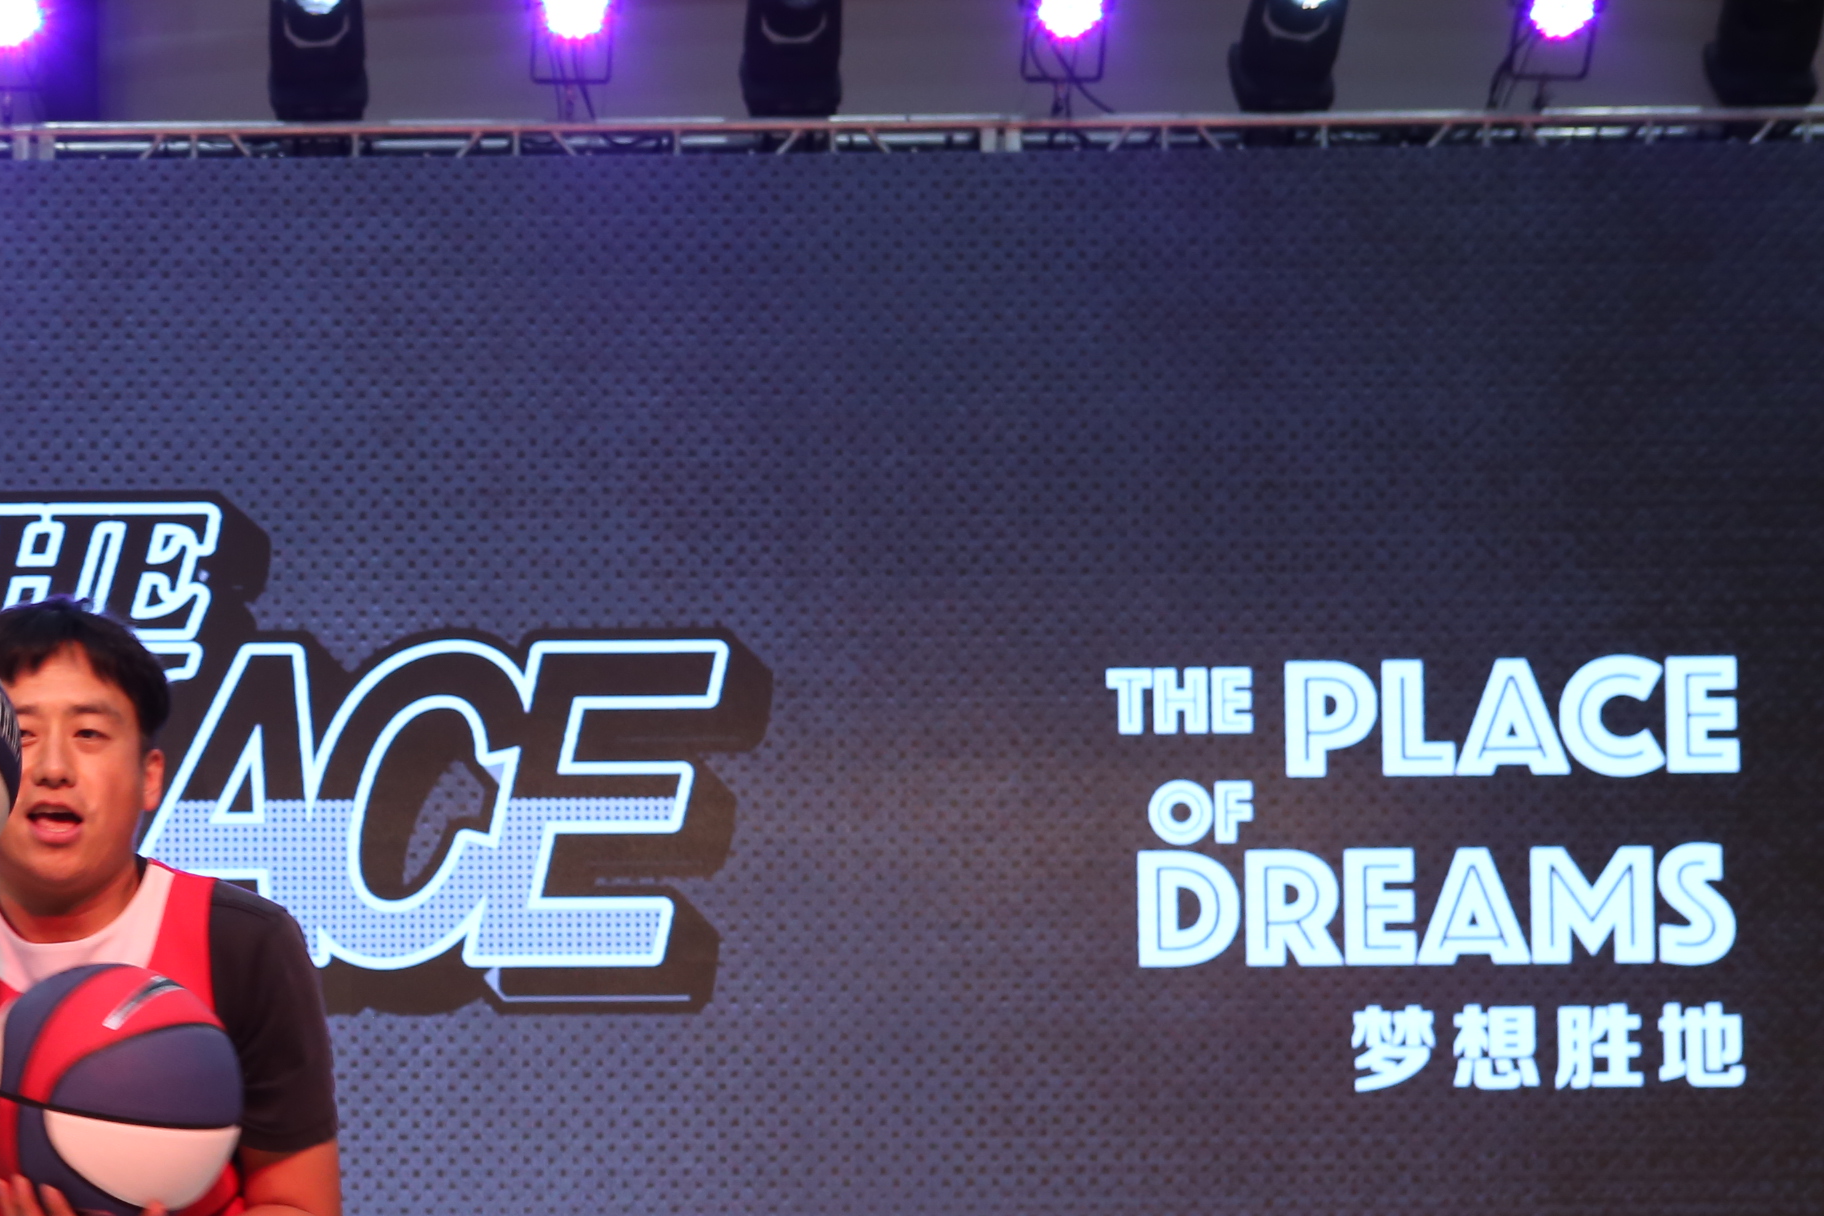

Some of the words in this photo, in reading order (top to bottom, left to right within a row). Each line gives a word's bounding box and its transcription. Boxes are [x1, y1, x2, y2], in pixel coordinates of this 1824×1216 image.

[1105, 667, 1253, 735] THE
[1284, 655, 1740, 778] PLACE
[1148, 779, 1253, 845] OF
[1137, 842, 1736, 967] DREAMS
[1351, 1002, 1745, 1092] 梦想胜地
